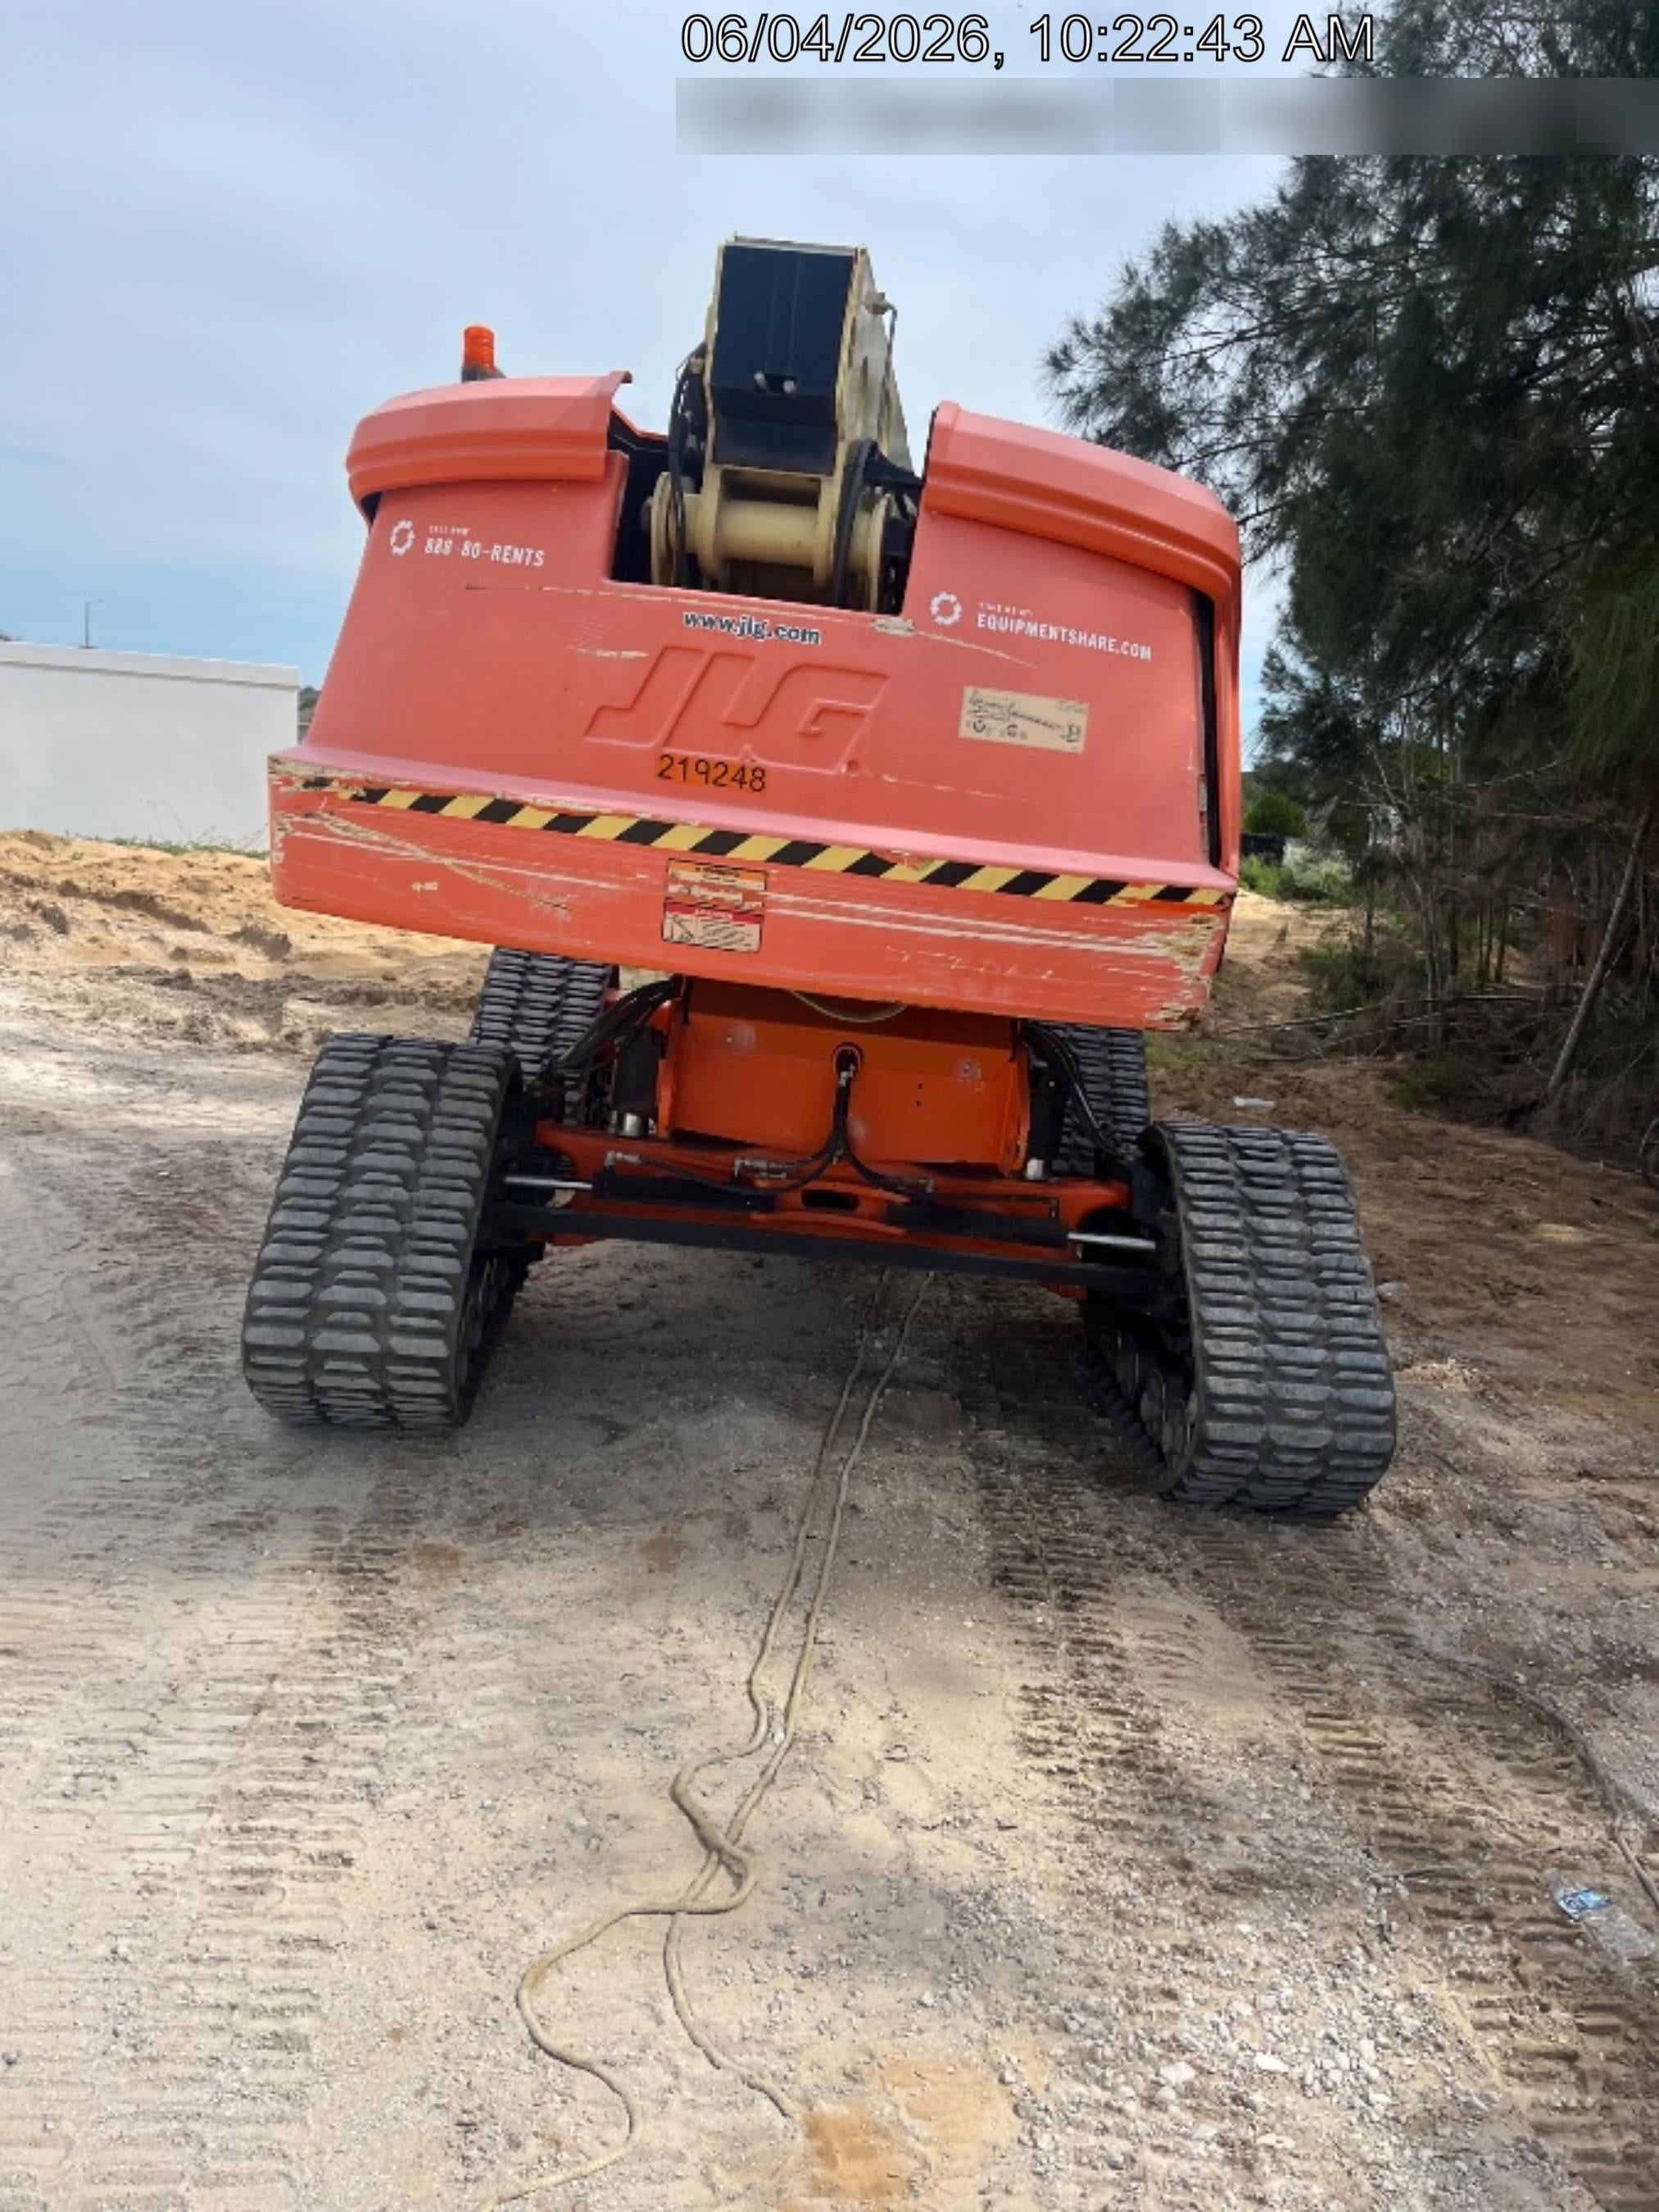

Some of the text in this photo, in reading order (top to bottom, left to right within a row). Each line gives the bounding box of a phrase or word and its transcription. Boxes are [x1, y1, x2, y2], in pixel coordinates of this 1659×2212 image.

[684, 611, 821, 645] www.jlg.com
[977, 613, 1152, 661] EQUIPMENTSHARE.COM
[583, 645, 890, 775] JLG
[658, 754, 766, 792] 219248
